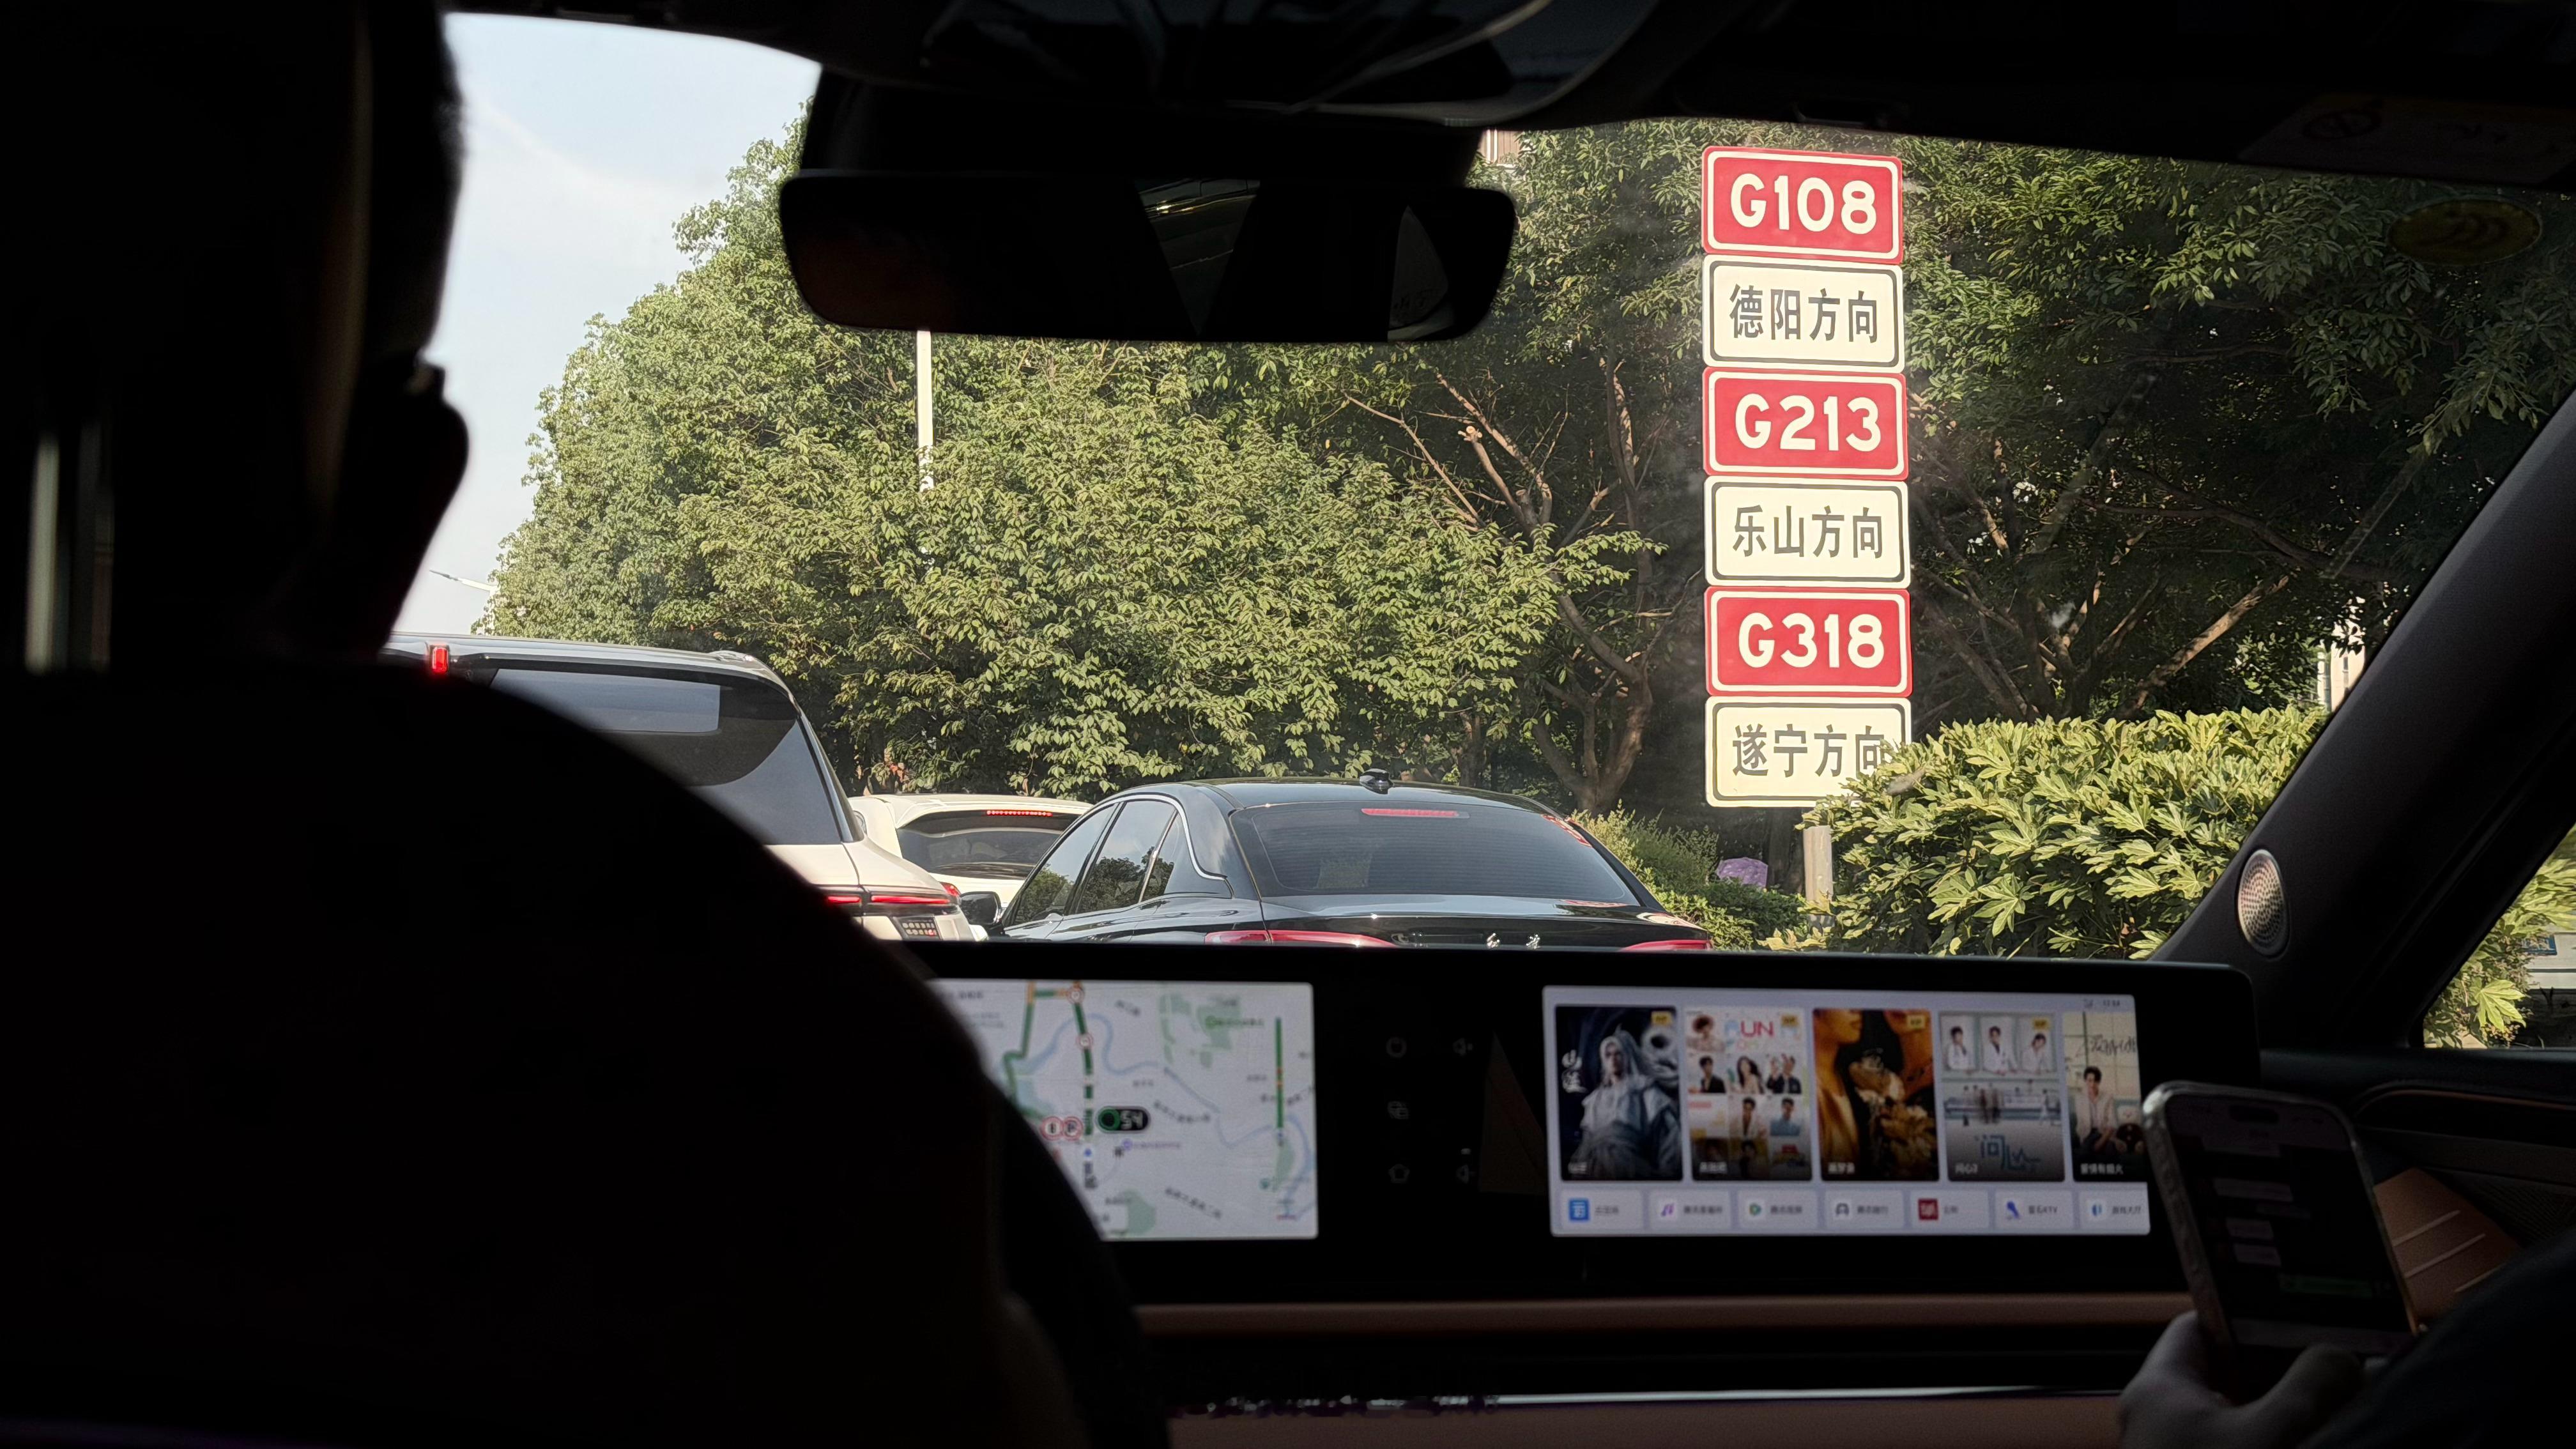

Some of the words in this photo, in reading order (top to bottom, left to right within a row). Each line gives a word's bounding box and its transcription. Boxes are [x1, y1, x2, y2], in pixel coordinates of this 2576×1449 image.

[1730, 173, 1877, 234] G108
[1729, 284, 1878, 343] 德阳方向
[1735, 393, 1881, 452] G213
[1732, 505, 1883, 558] 乐山方向
[1738, 612, 1884, 668] G318
[1733, 724, 1885, 778] 遂宁方向
